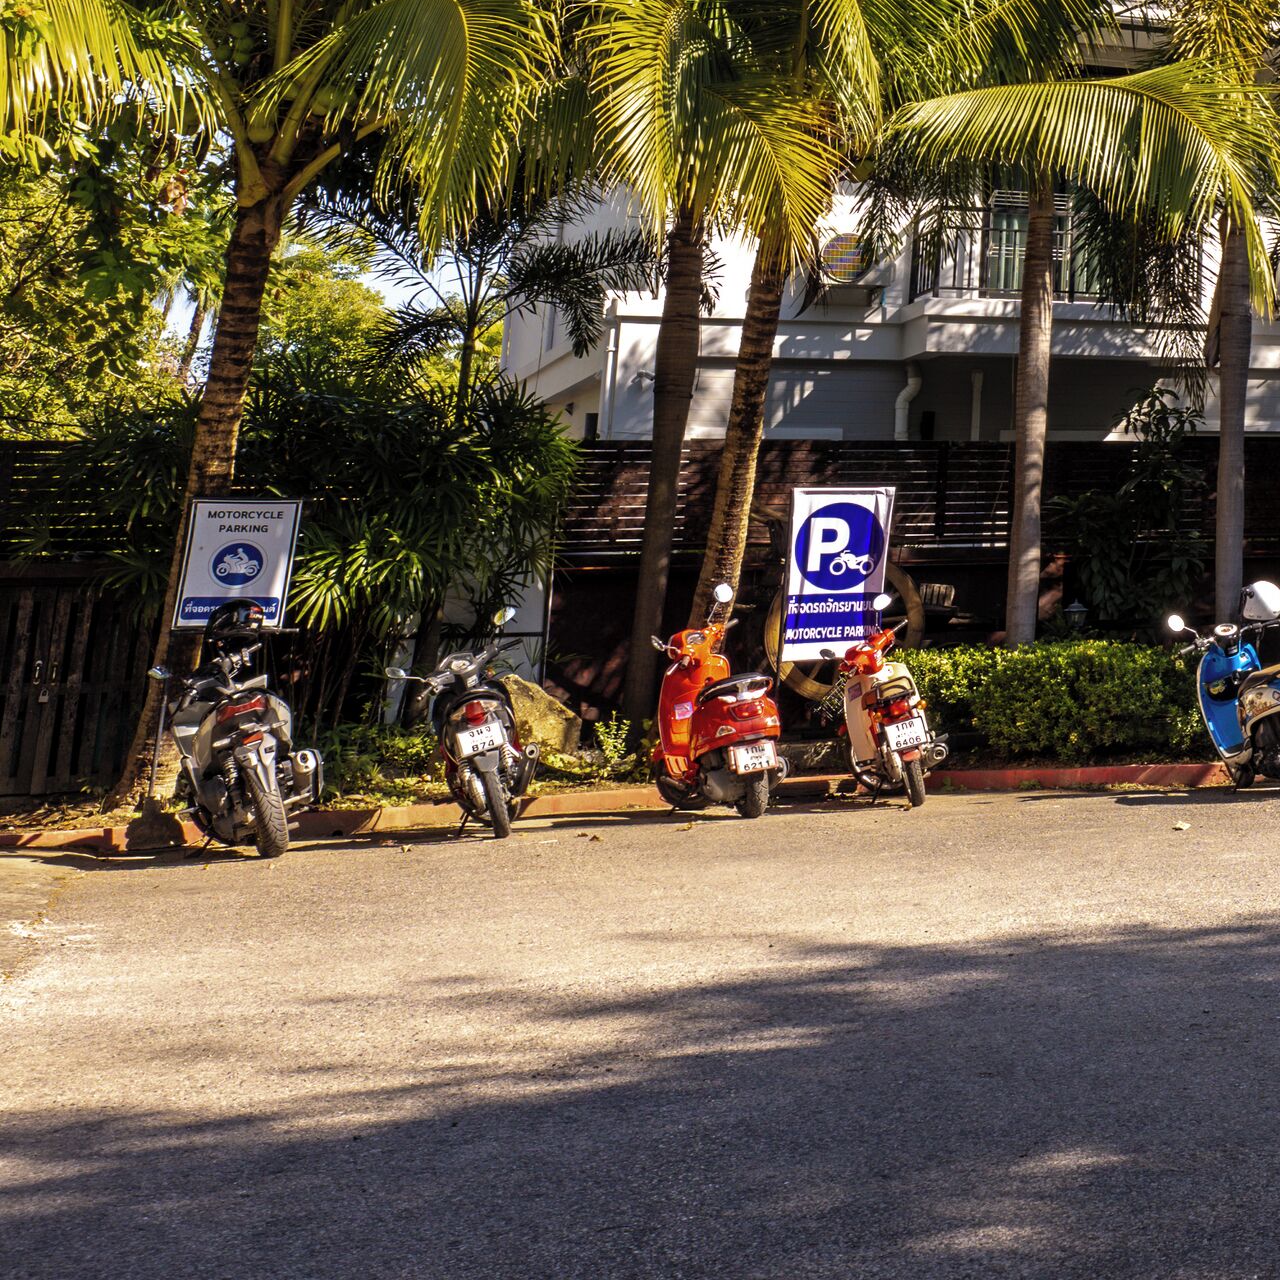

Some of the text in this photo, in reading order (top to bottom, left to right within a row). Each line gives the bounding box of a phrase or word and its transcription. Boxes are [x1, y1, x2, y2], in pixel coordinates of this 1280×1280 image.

[207, 510, 284, 520] MOTORCYCLE
[218, 524, 269, 533] PARKING
[807, 517, 850, 572] P
[785, 626, 842, 640] MOTORCYCLE
[471, 739, 495, 752] 874
[895, 735, 922, 748] 6406
[743, 760, 771, 771] 6211
